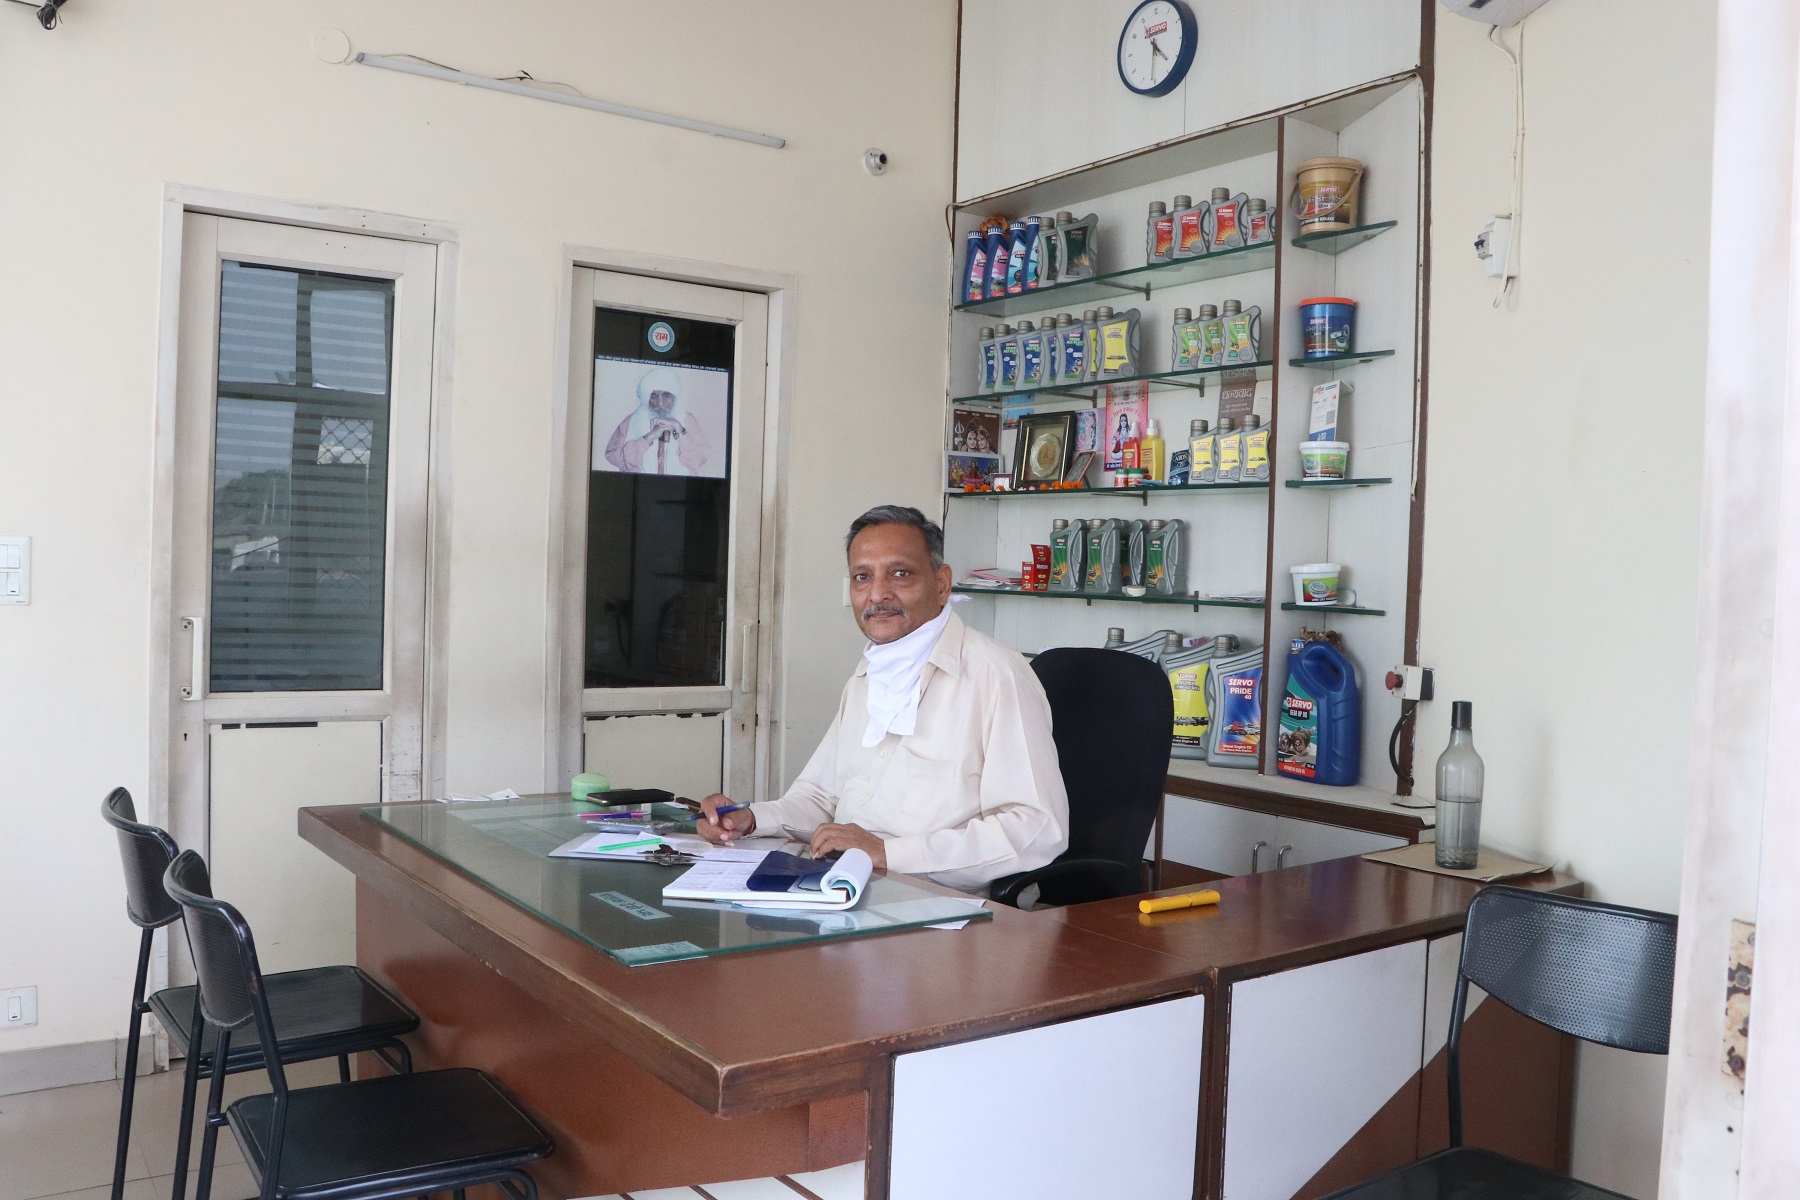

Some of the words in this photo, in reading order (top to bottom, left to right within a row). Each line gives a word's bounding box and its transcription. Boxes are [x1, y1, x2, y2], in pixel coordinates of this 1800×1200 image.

[655, 331, 668, 342] राम
[1221, 388, 1252, 400] धन्यवाद
[1228, 678, 1253, 687] SERVO
[1230, 687, 1252, 695] PRIDE
[1291, 698, 1313, 710] SERVO
